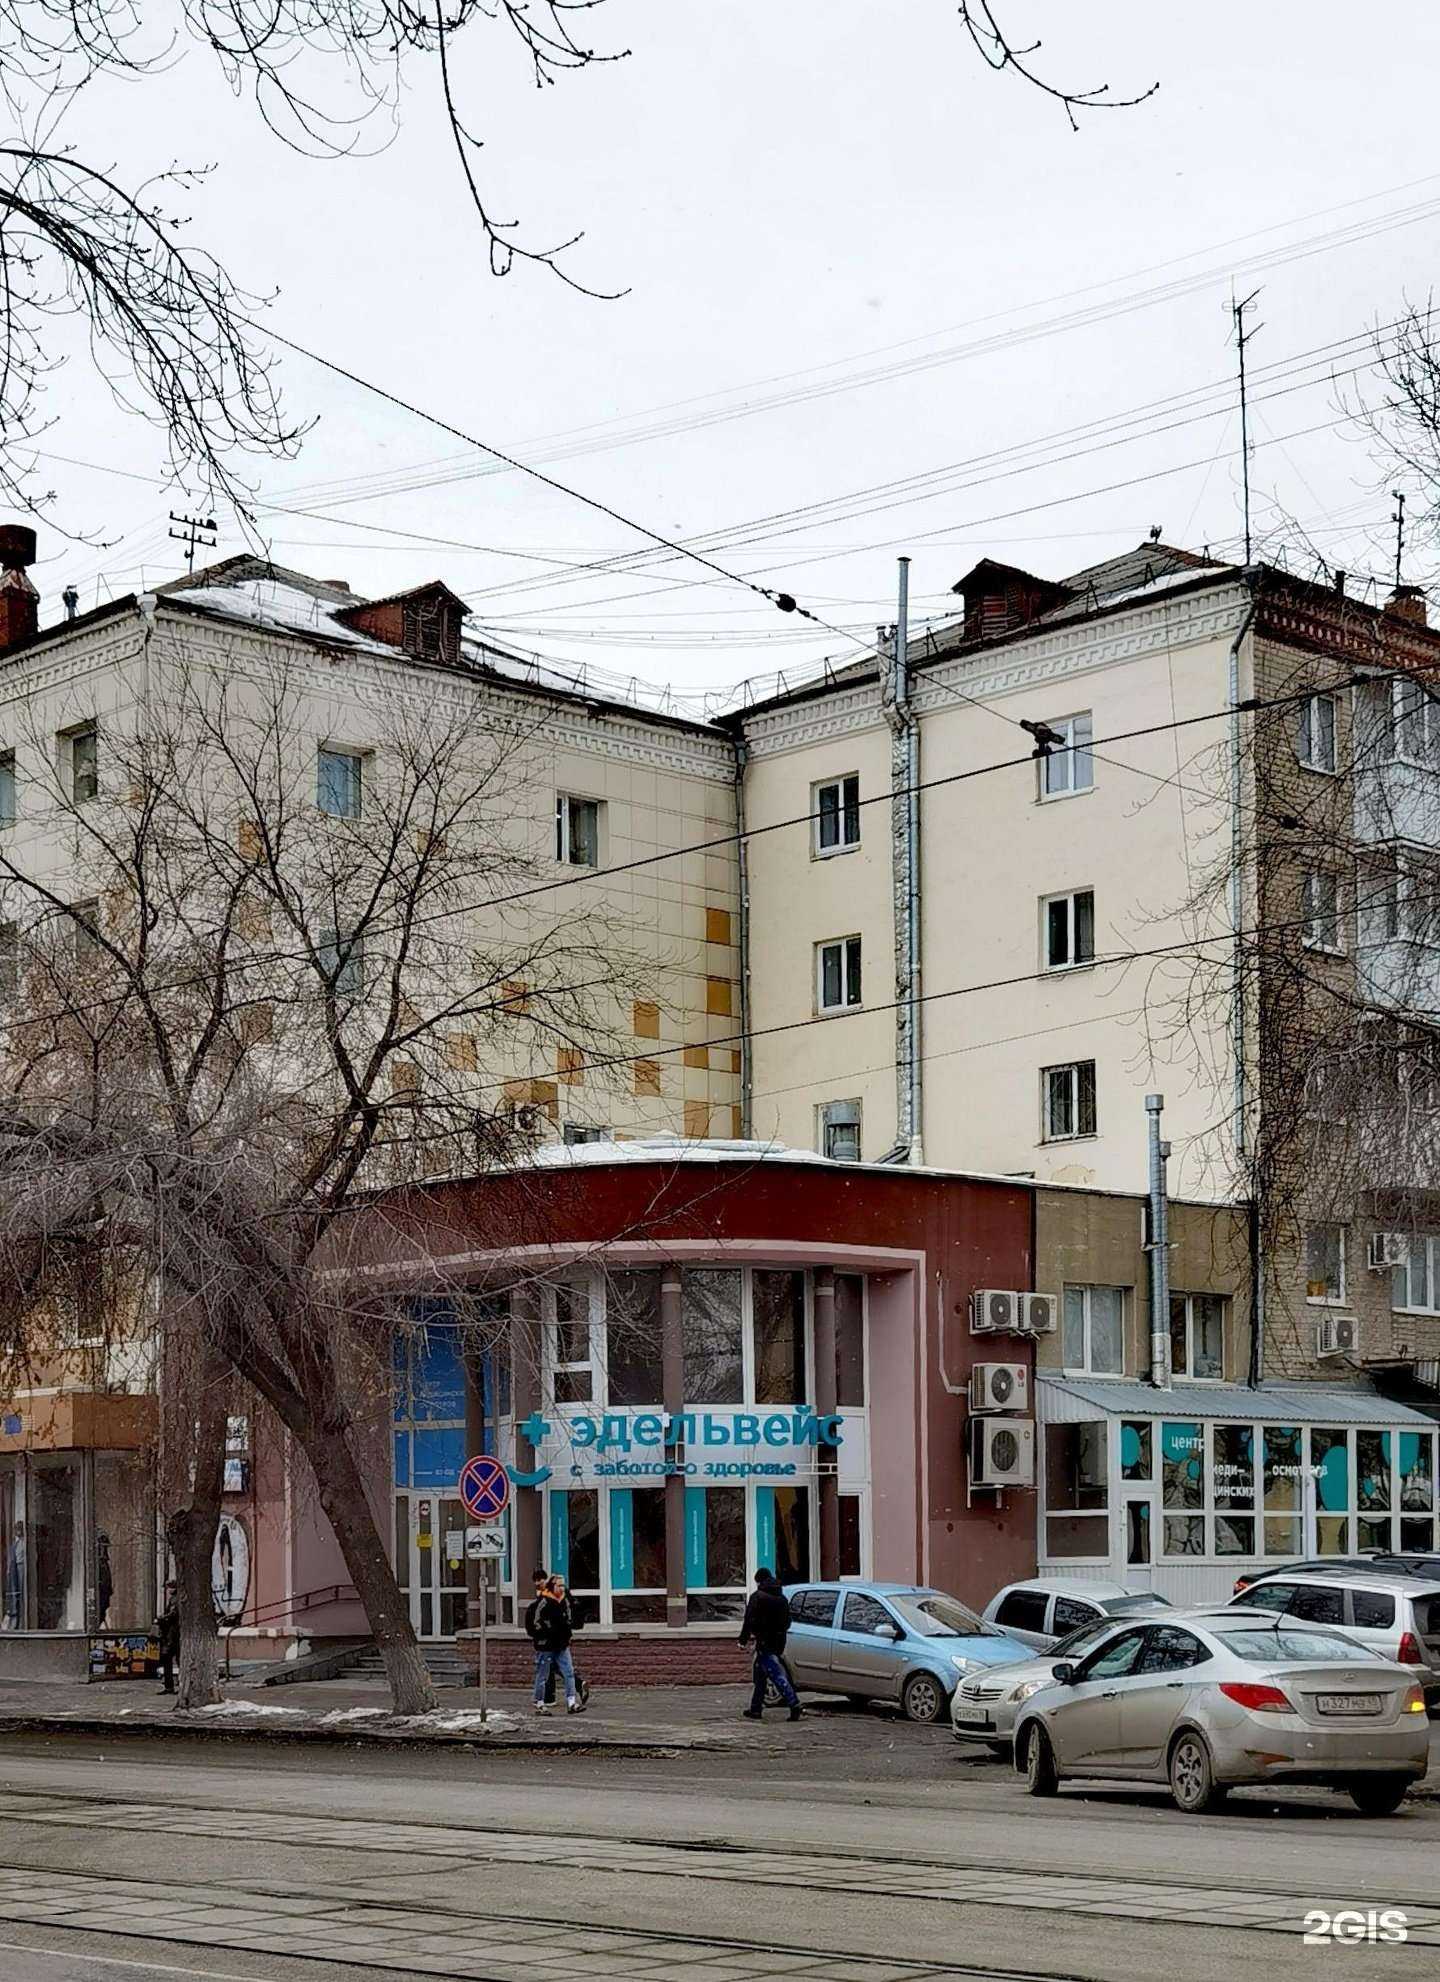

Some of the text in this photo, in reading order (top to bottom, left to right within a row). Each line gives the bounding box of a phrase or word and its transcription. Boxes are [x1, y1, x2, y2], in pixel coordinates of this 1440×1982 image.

[570, 1405, 844, 1453] эдельвейс
[593, 1459, 676, 1476] заботой
[703, 1462, 796, 1478] здоровье
